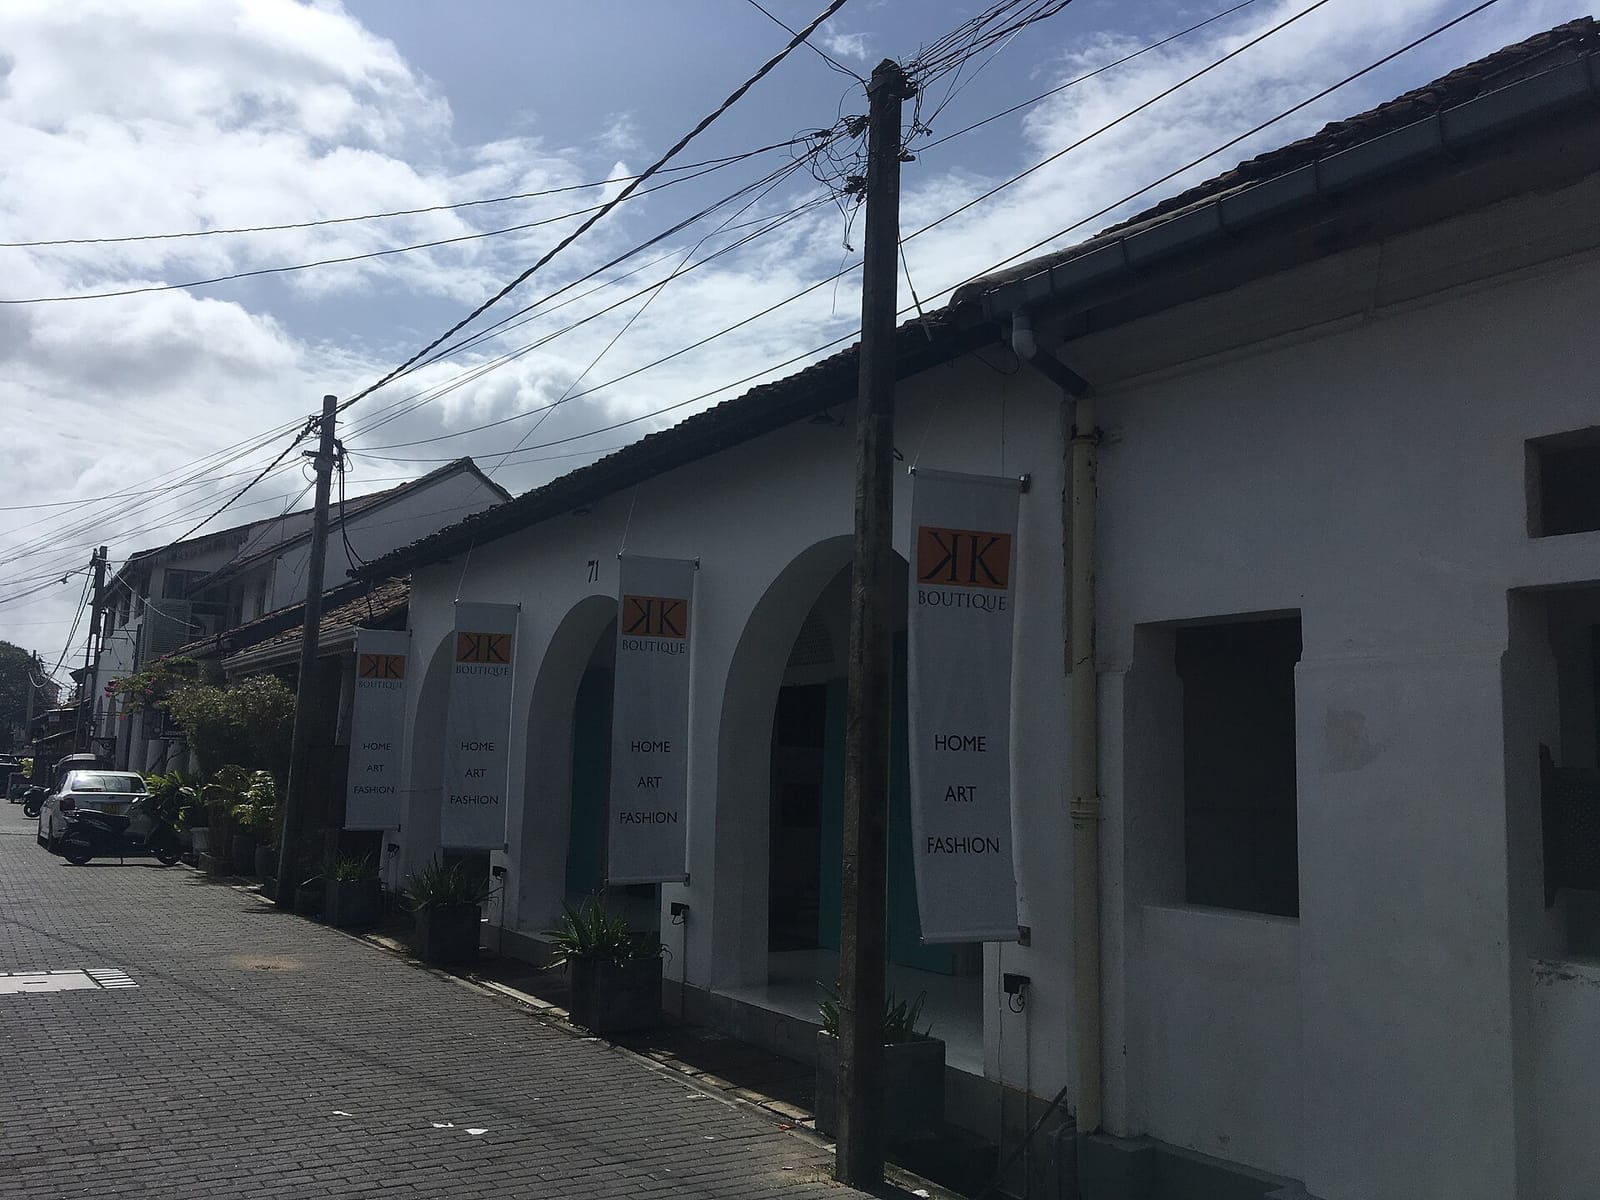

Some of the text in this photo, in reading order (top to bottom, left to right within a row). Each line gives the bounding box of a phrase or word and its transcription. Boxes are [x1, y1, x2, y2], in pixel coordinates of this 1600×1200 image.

[586, 560, 600, 583] 71
[918, 590, 1006, 613] BOUTIQUE
[621, 639, 686, 655] BOUTIQUE
[455, 664, 510, 677] BOUTIQUE
[362, 742, 392, 752] HOME
[460, 741, 495, 752] HOME
[631, 740, 671, 753] HOME
[935, 734, 987, 753] HOME
[366, 763, 385, 772] ART
[464, 767, 487, 778] ART
[637, 776, 663, 789] ART
[353, 785, 395, 795] FASHION
[944, 785, 977, 803] ART
[450, 794, 499, 805] FASHION
[619, 811, 678, 825] FASHION
[927, 837, 1000, 854] FASHION
